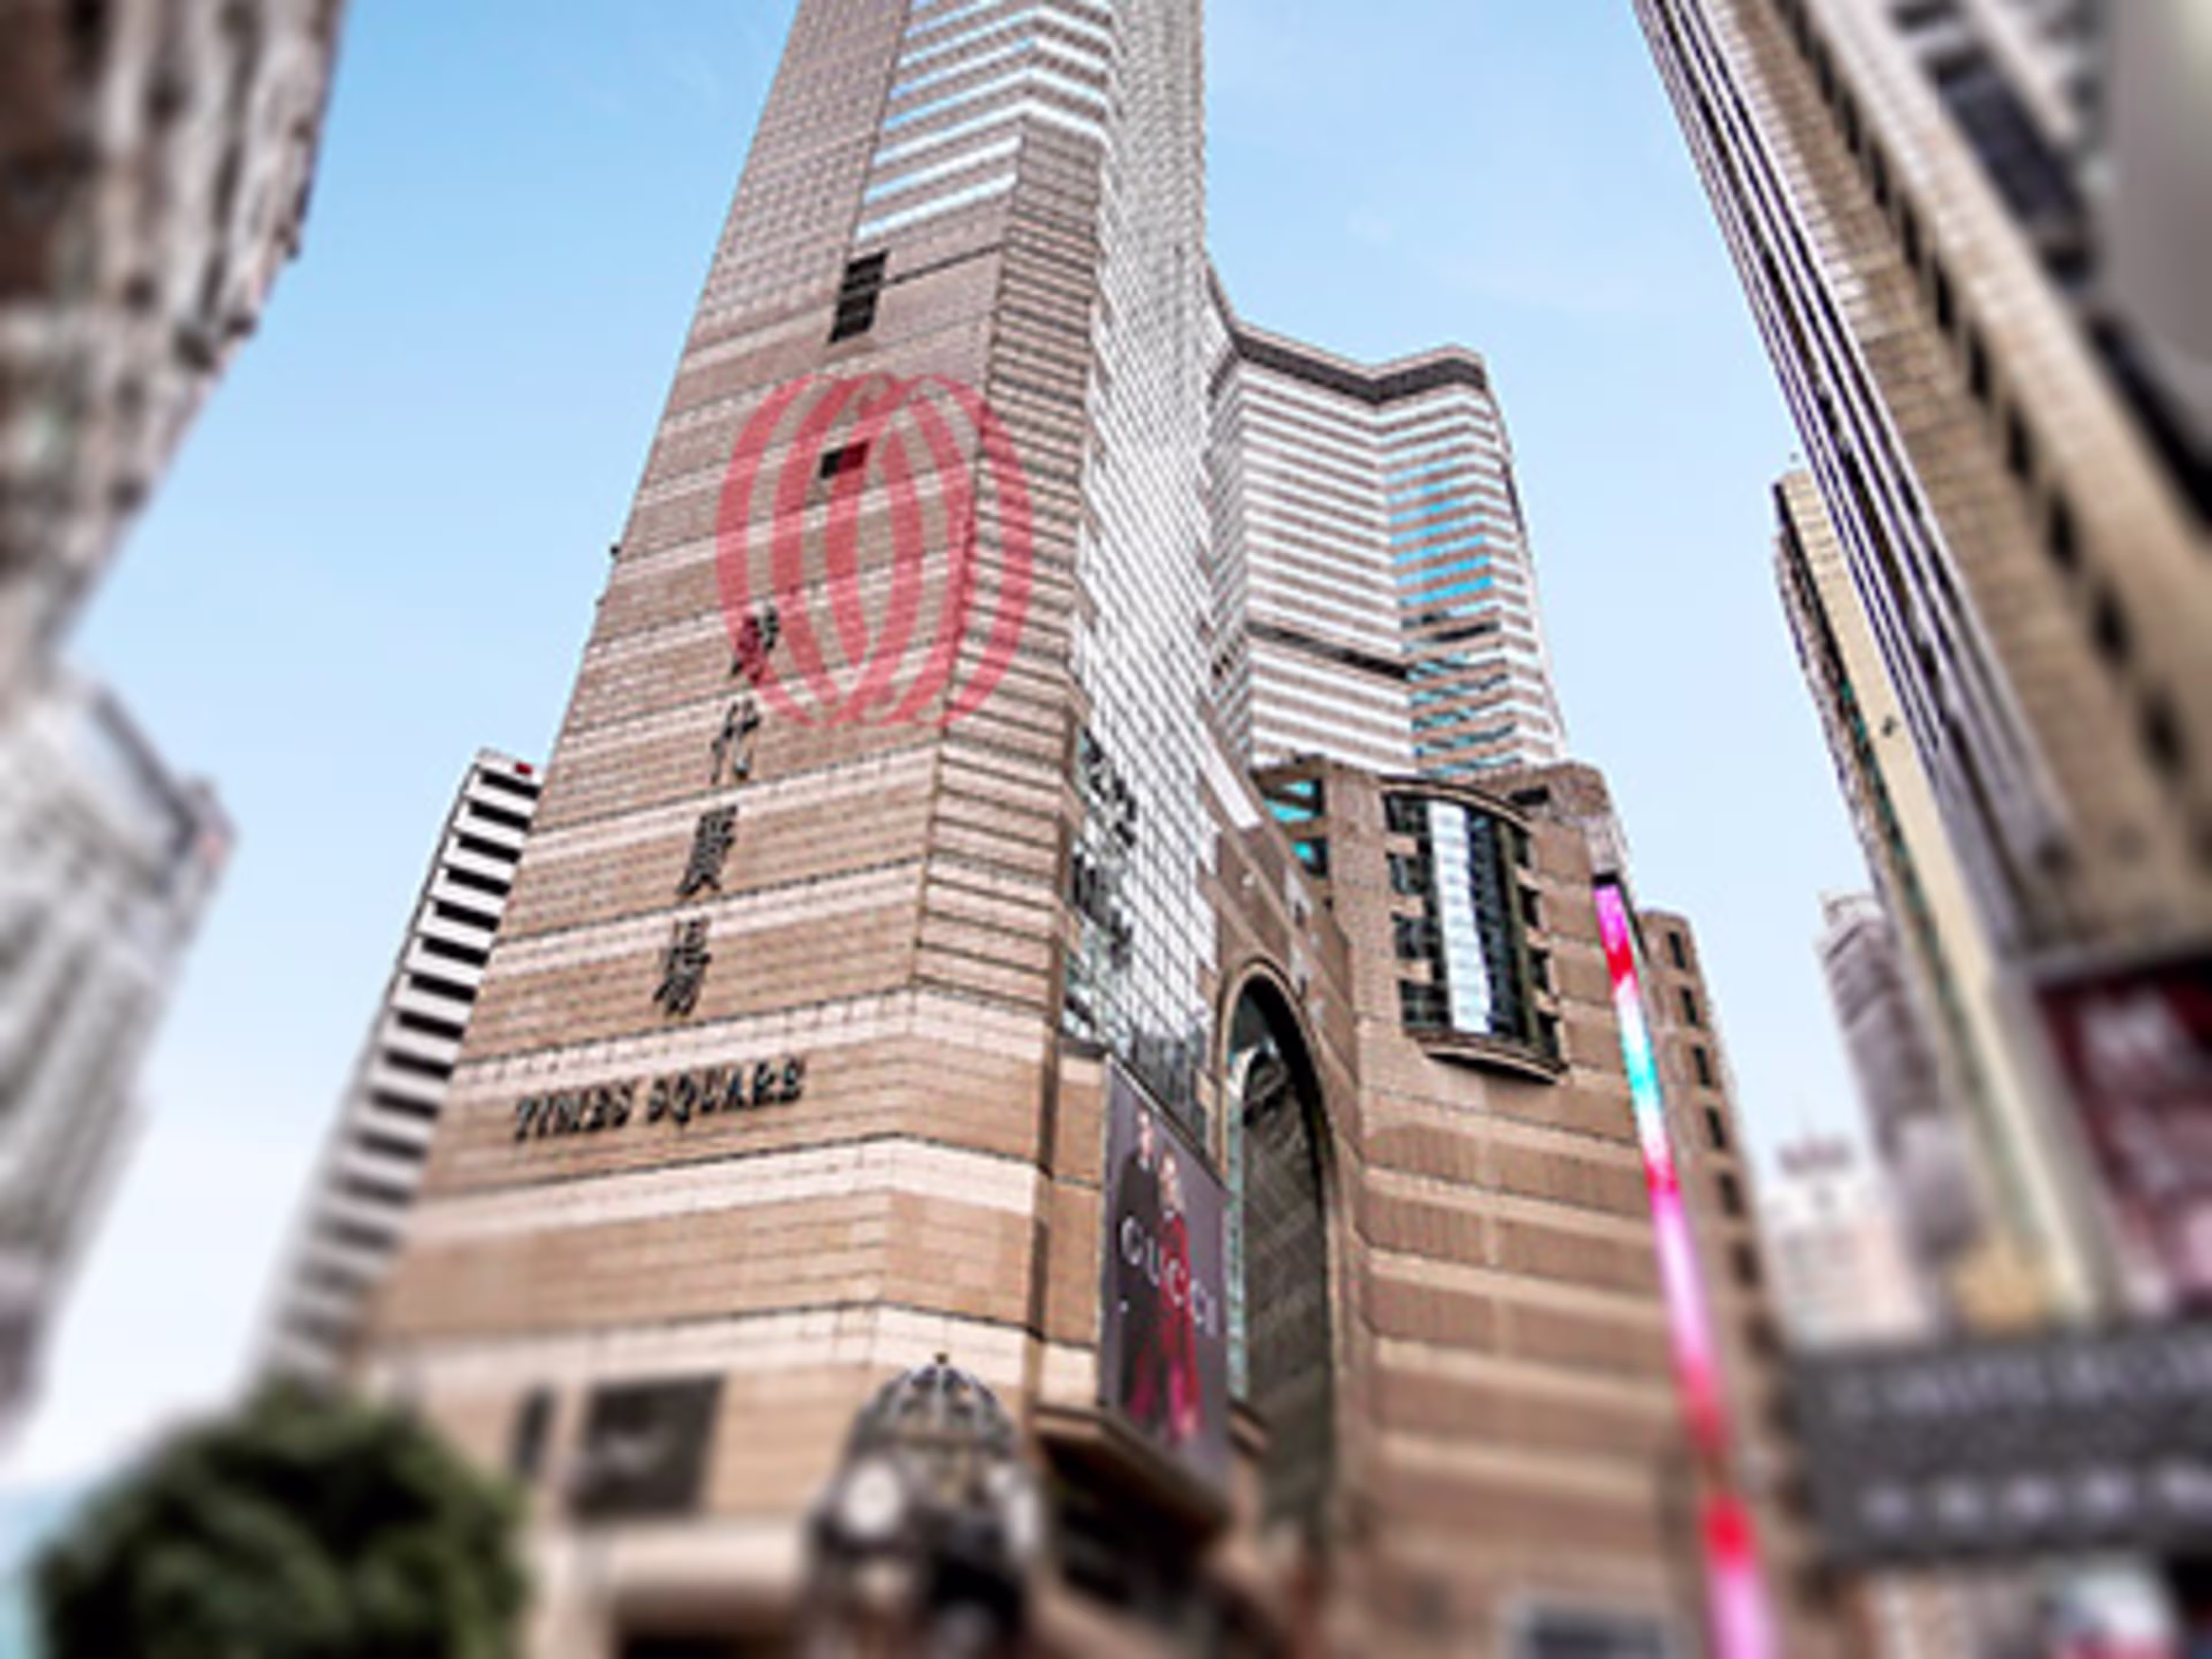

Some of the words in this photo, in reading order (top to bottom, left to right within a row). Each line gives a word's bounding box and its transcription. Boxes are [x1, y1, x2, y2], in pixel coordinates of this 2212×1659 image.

[515, 1078, 636, 1139] TIMES
[646, 1055, 804, 1130] SQUARE
[1121, 1215, 1217, 1336] GUCCI
